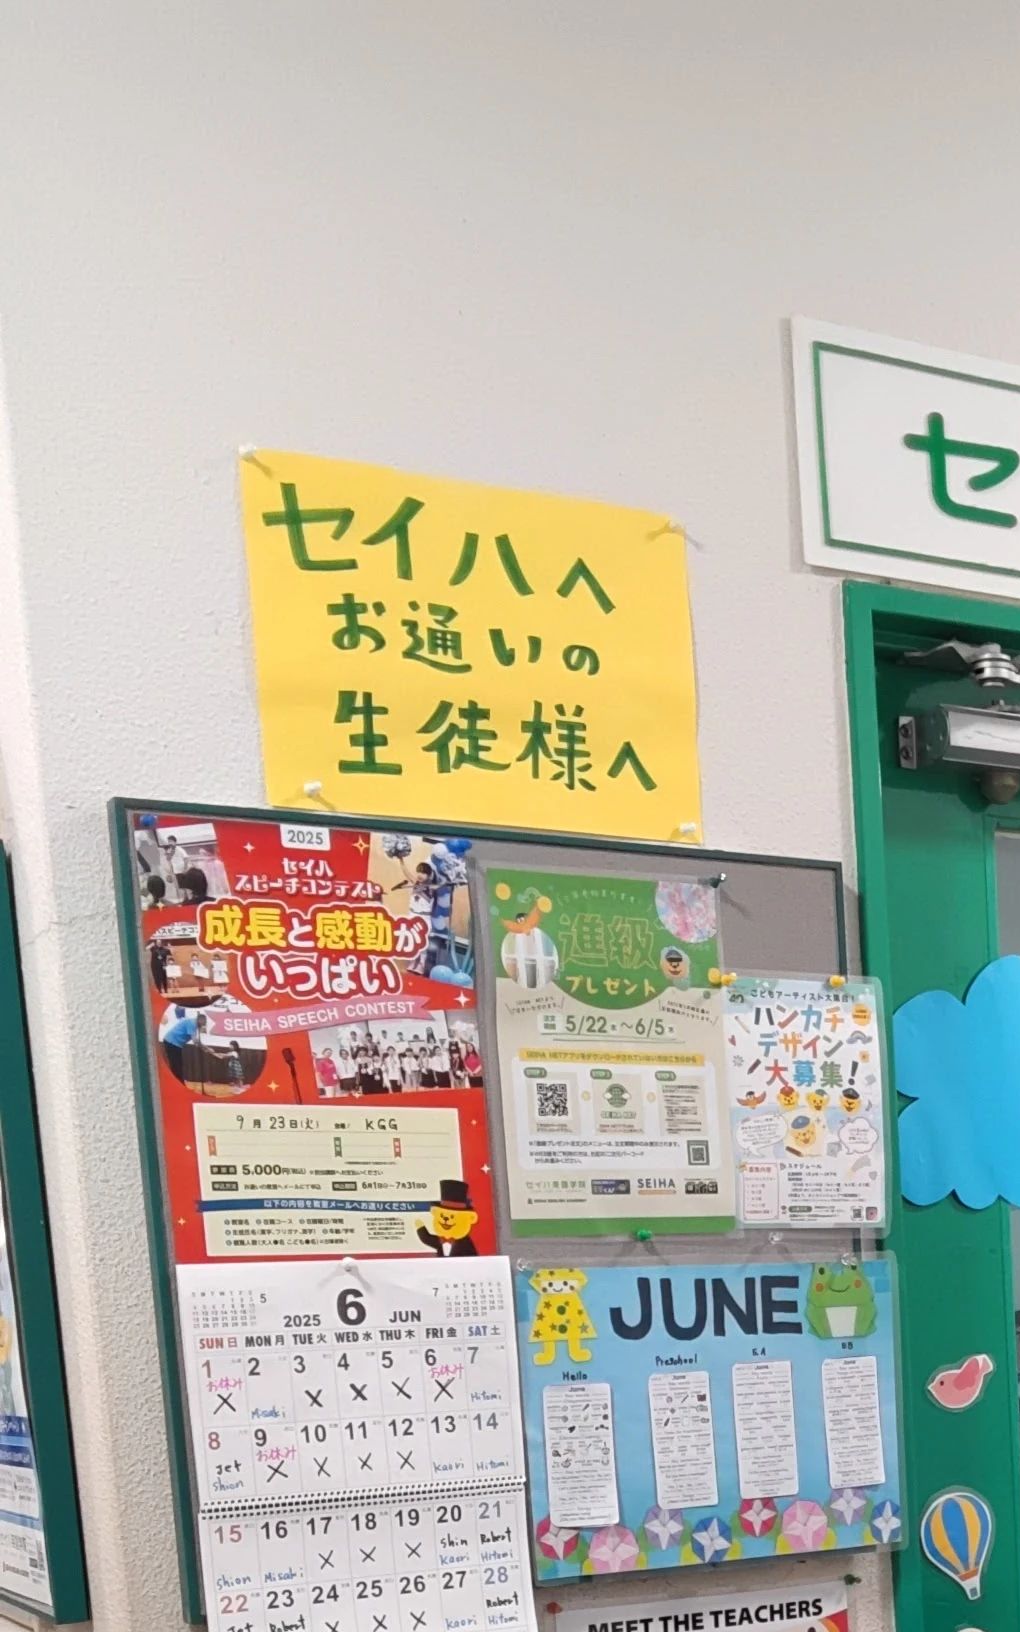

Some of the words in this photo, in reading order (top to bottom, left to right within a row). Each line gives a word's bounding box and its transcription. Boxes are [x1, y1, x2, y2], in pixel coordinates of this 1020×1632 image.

[262, 482, 616, 614] セイハへ
[326, 592, 601, 675] お通いの
[331, 689, 657, 792] 生徒様へ
[288, 830, 324, 845] 2025
[281, 857, 334, 876] セイハ
[235, 873, 382, 898] スピーチコンテスト
[204, 906, 429, 952] 成長と感動が
[558, 913, 657, 970] 進級
[246, 955, 397, 995] いっぱい
[566, 976, 657, 996] プレゼント
[223, 1015, 272, 1032] SEIHA
[277, 1008, 339, 1029] SPEECH
[345, 1001, 415, 1020] CONTEST
[754, 1005, 845, 1033] ハンカチ
[758, 1030, 843, 1058] デザイン
[637, 1178, 676, 1188] SEIHA
[259, 1293, 267, 1303] 5
[283, 1314, 321, 1327] 2025
[336, 1288, 367, 1326] 6
[389, 1310, 421, 1323] JUN
[432, 1288, 439, 1297] 7
[609, 1275, 803, 1341] JUNE
[200, 1337, 224, 1349] SUN
[228, 1336, 238, 1347] 日
[245, 1336, 271, 1347] MON
[275, 1335, 285, 1346] 月
[292, 1333, 313, 1345] TUE
[316, 1332, 327, 1344] 火
[335, 1331, 359, 1343] WED
[362, 1331, 373, 1342] 水
[379, 1329, 401, 1341] THU
[405, 1328, 415, 1339] 木
[426, 1327, 444, 1339] FRI
[447, 1326, 457, 1337] 金
[468, 1326, 487, 1336] SAT
[491, 1325, 500, 1336] 土
[201, 1360, 212, 1378] 1
[248, 1357, 261, 1376] 2
[294, 1355, 306, 1373] 3
[337, 1353, 350, 1371] 4
[382, 1351, 393, 1368] 5
[425, 1349, 436, 1366] 6
[467, 1347, 479, 1364] 7
[562, 1371, 588, 1383] Hello
[208, 1431, 221, 1451] 8
[254, 1428, 267, 1448] 9
[300, 1424, 327, 1444] 10
[344, 1421, 368, 1440] 11
[388, 1418, 414, 1438] 12
[431, 1415, 457, 1434] 13
[472, 1413, 499, 1431] 14
[214, 1524, 242, 1544] 15
[260, 1521, 288, 1540] 16
[306, 1517, 332, 1536] 17
[350, 1512, 377, 1531] 18
[394, 1508, 420, 1527] 19
[436, 1505, 462, 1523] 20
[478, 1500, 502, 1519] 21
[220, 1594, 249, 1614] 22
[266, 1589, 294, 1609] 23
[311, 1584, 339, 1604] 24
[356, 1580, 383, 1599] 25
[399, 1575, 426, 1594] 26
[442, 1571, 467, 1590] 27
[484, 1566, 509, 1585] 28
[658, 1612, 705, 1632] THE
[709, 1598, 823, 1629] TEACHERS
